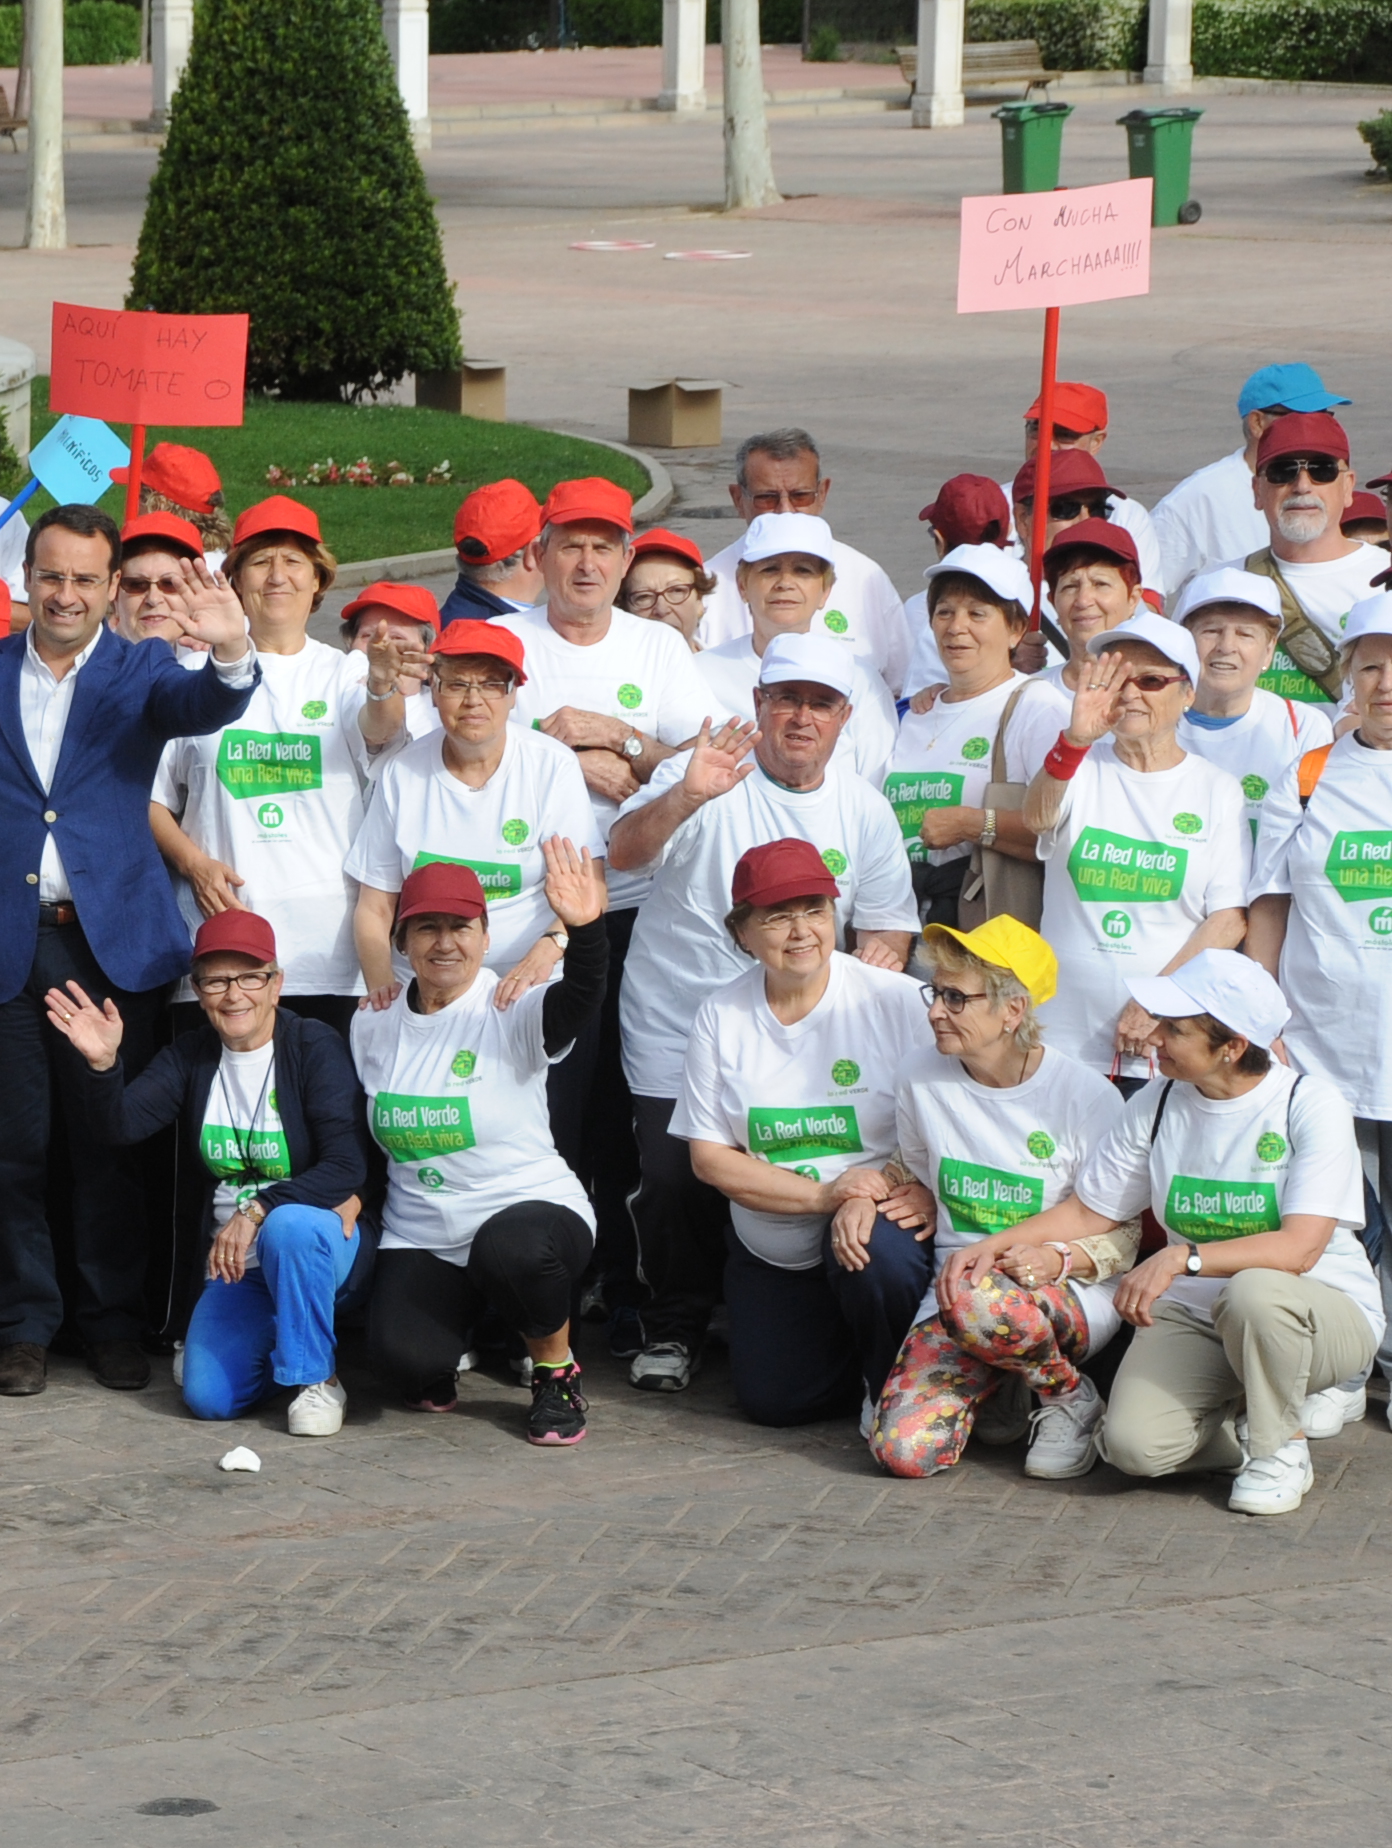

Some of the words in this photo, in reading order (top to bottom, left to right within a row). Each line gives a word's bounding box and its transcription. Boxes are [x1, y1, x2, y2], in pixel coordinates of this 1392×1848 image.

[986, 208, 1033, 234] CON
[157, 328, 208, 353] HAY
[75, 359, 185, 397] TOMATE
[1279, 674, 1307, 695] Red
[227, 741, 243, 761] La
[246, 739, 272, 761] Red
[275, 739, 312, 761] Verde
[228, 766, 254, 784] una
[257, 763, 283, 784] Red
[286, 763, 313, 785] viva
[885, 784, 897, 803] La
[898, 780, 920, 802] Red
[920, 778, 953, 800] Verde
[1080, 839, 1100, 860] La
[1102, 842, 1133, 865] Red
[1135, 849, 1177, 872] Verde
[1339, 839, 1359, 861] La
[1361, 840, 1392, 861] Red
[1078, 866, 1106, 887] una
[1109, 867, 1139, 892] Red
[1142, 872, 1172, 897] viva
[1339, 867, 1369, 886] una
[1373, 863, 1392, 886] Re
[848, 1087, 869, 1095] VERDE
[377, 1107, 390, 1127] La
[392, 1106, 418, 1128] Red
[420, 1104, 460, 1127] Verde
[755, 1122, 773, 1141] La
[775, 1118, 803, 1140] Red
[805, 1113, 848, 1136] Verde
[207, 1138, 223, 1160] La
[382, 1133, 405, 1148] una
[407, 1130, 433, 1149] Red
[434, 1129, 465, 1148] viva
[943, 1173, 959, 1196] La
[962, 1175, 989, 1199] Red
[993, 1179, 1033, 1205] Verde
[971, 1201, 998, 1224] Red
[1174, 1191, 1191, 1214] La
[1193, 1191, 1221, 1214] Red
[1224, 1190, 1266, 1214] Verde
